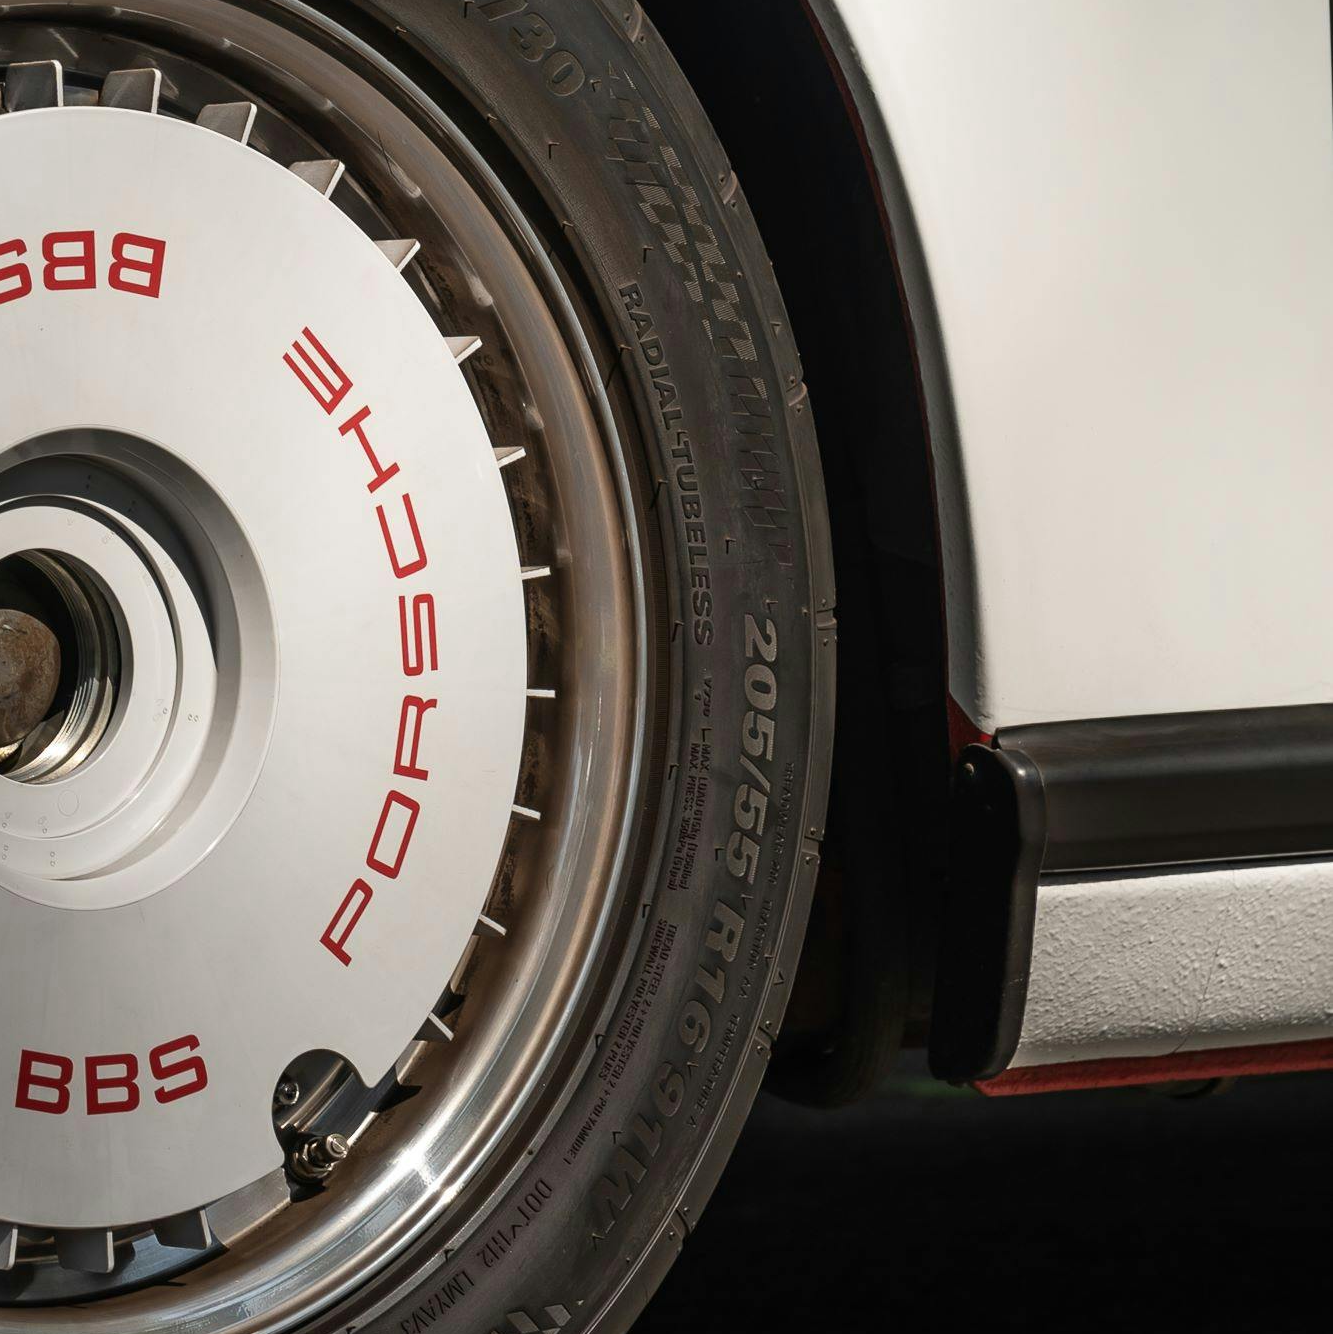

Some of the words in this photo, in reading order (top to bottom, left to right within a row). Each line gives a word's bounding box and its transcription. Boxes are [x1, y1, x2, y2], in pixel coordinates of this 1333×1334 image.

[619, 282, 682, 431] RADIAL
[669, 439, 713, 645] TUBELESS
[283, 327, 437, 966] PORSCHE
[726, 612, 778, 885] 205/55
[678, 900, 745, 1054] R16
[16, 1035, 207, 1115] BBS
[588, 1061, 685, 1234] 91W
[514, 1176, 553, 1226] DOT
